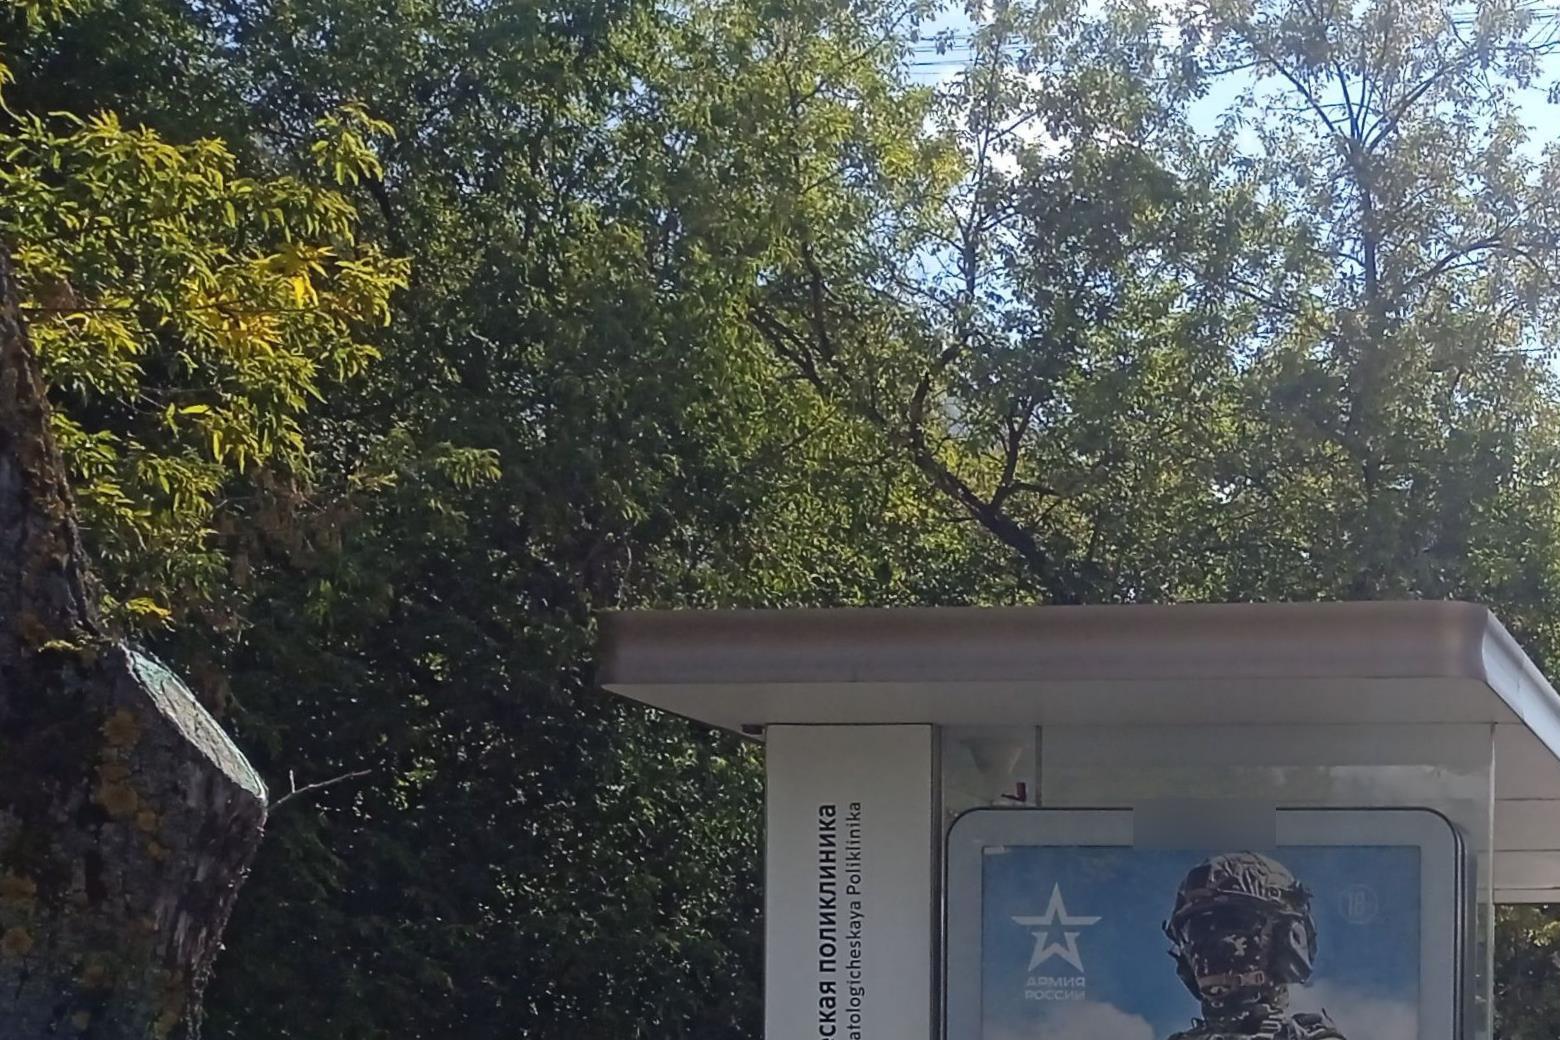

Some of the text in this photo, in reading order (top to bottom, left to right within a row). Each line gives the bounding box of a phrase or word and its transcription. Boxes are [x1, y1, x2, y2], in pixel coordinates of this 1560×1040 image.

[845, 801, 862, 896] Poliklinika
[818, 803, 837, 973] поликлиника
[1024, 990, 1086, 1001] РОССИИ
[1026, 976, 1085, 987] АРМИЯ
